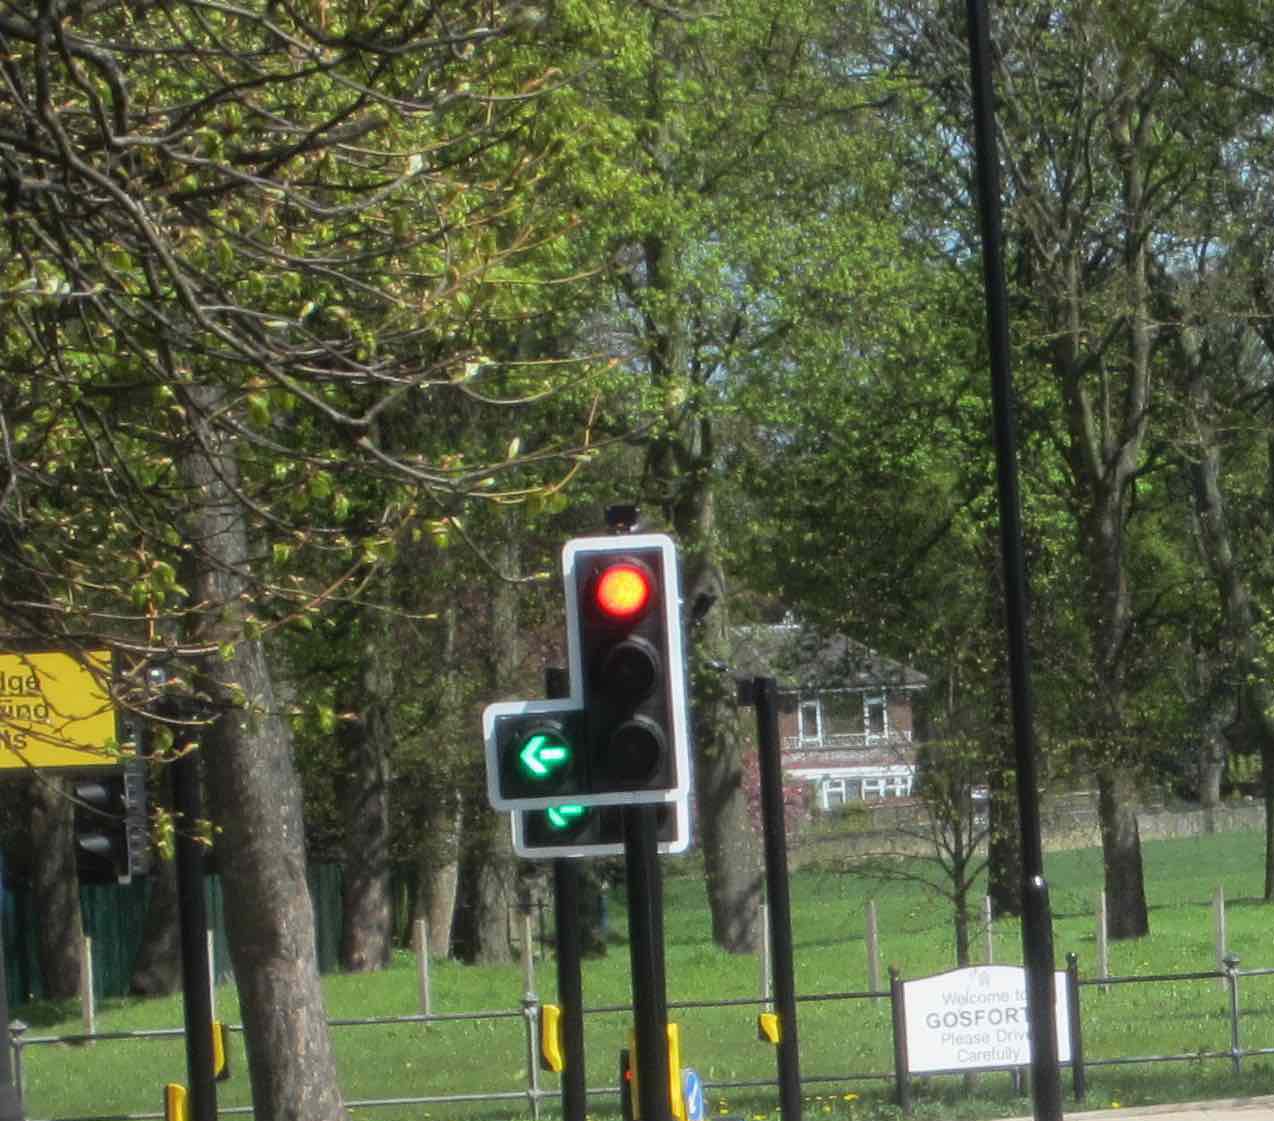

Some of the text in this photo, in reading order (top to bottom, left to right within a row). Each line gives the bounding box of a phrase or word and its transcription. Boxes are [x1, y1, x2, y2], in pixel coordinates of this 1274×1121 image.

[942, 990, 1009, 1006] Welcome
[926, 1006, 1026, 1029] GOSFOR
[941, 1028, 1025, 1046] Please Driv
[958, 1046, 1021, 1063] Carefully
